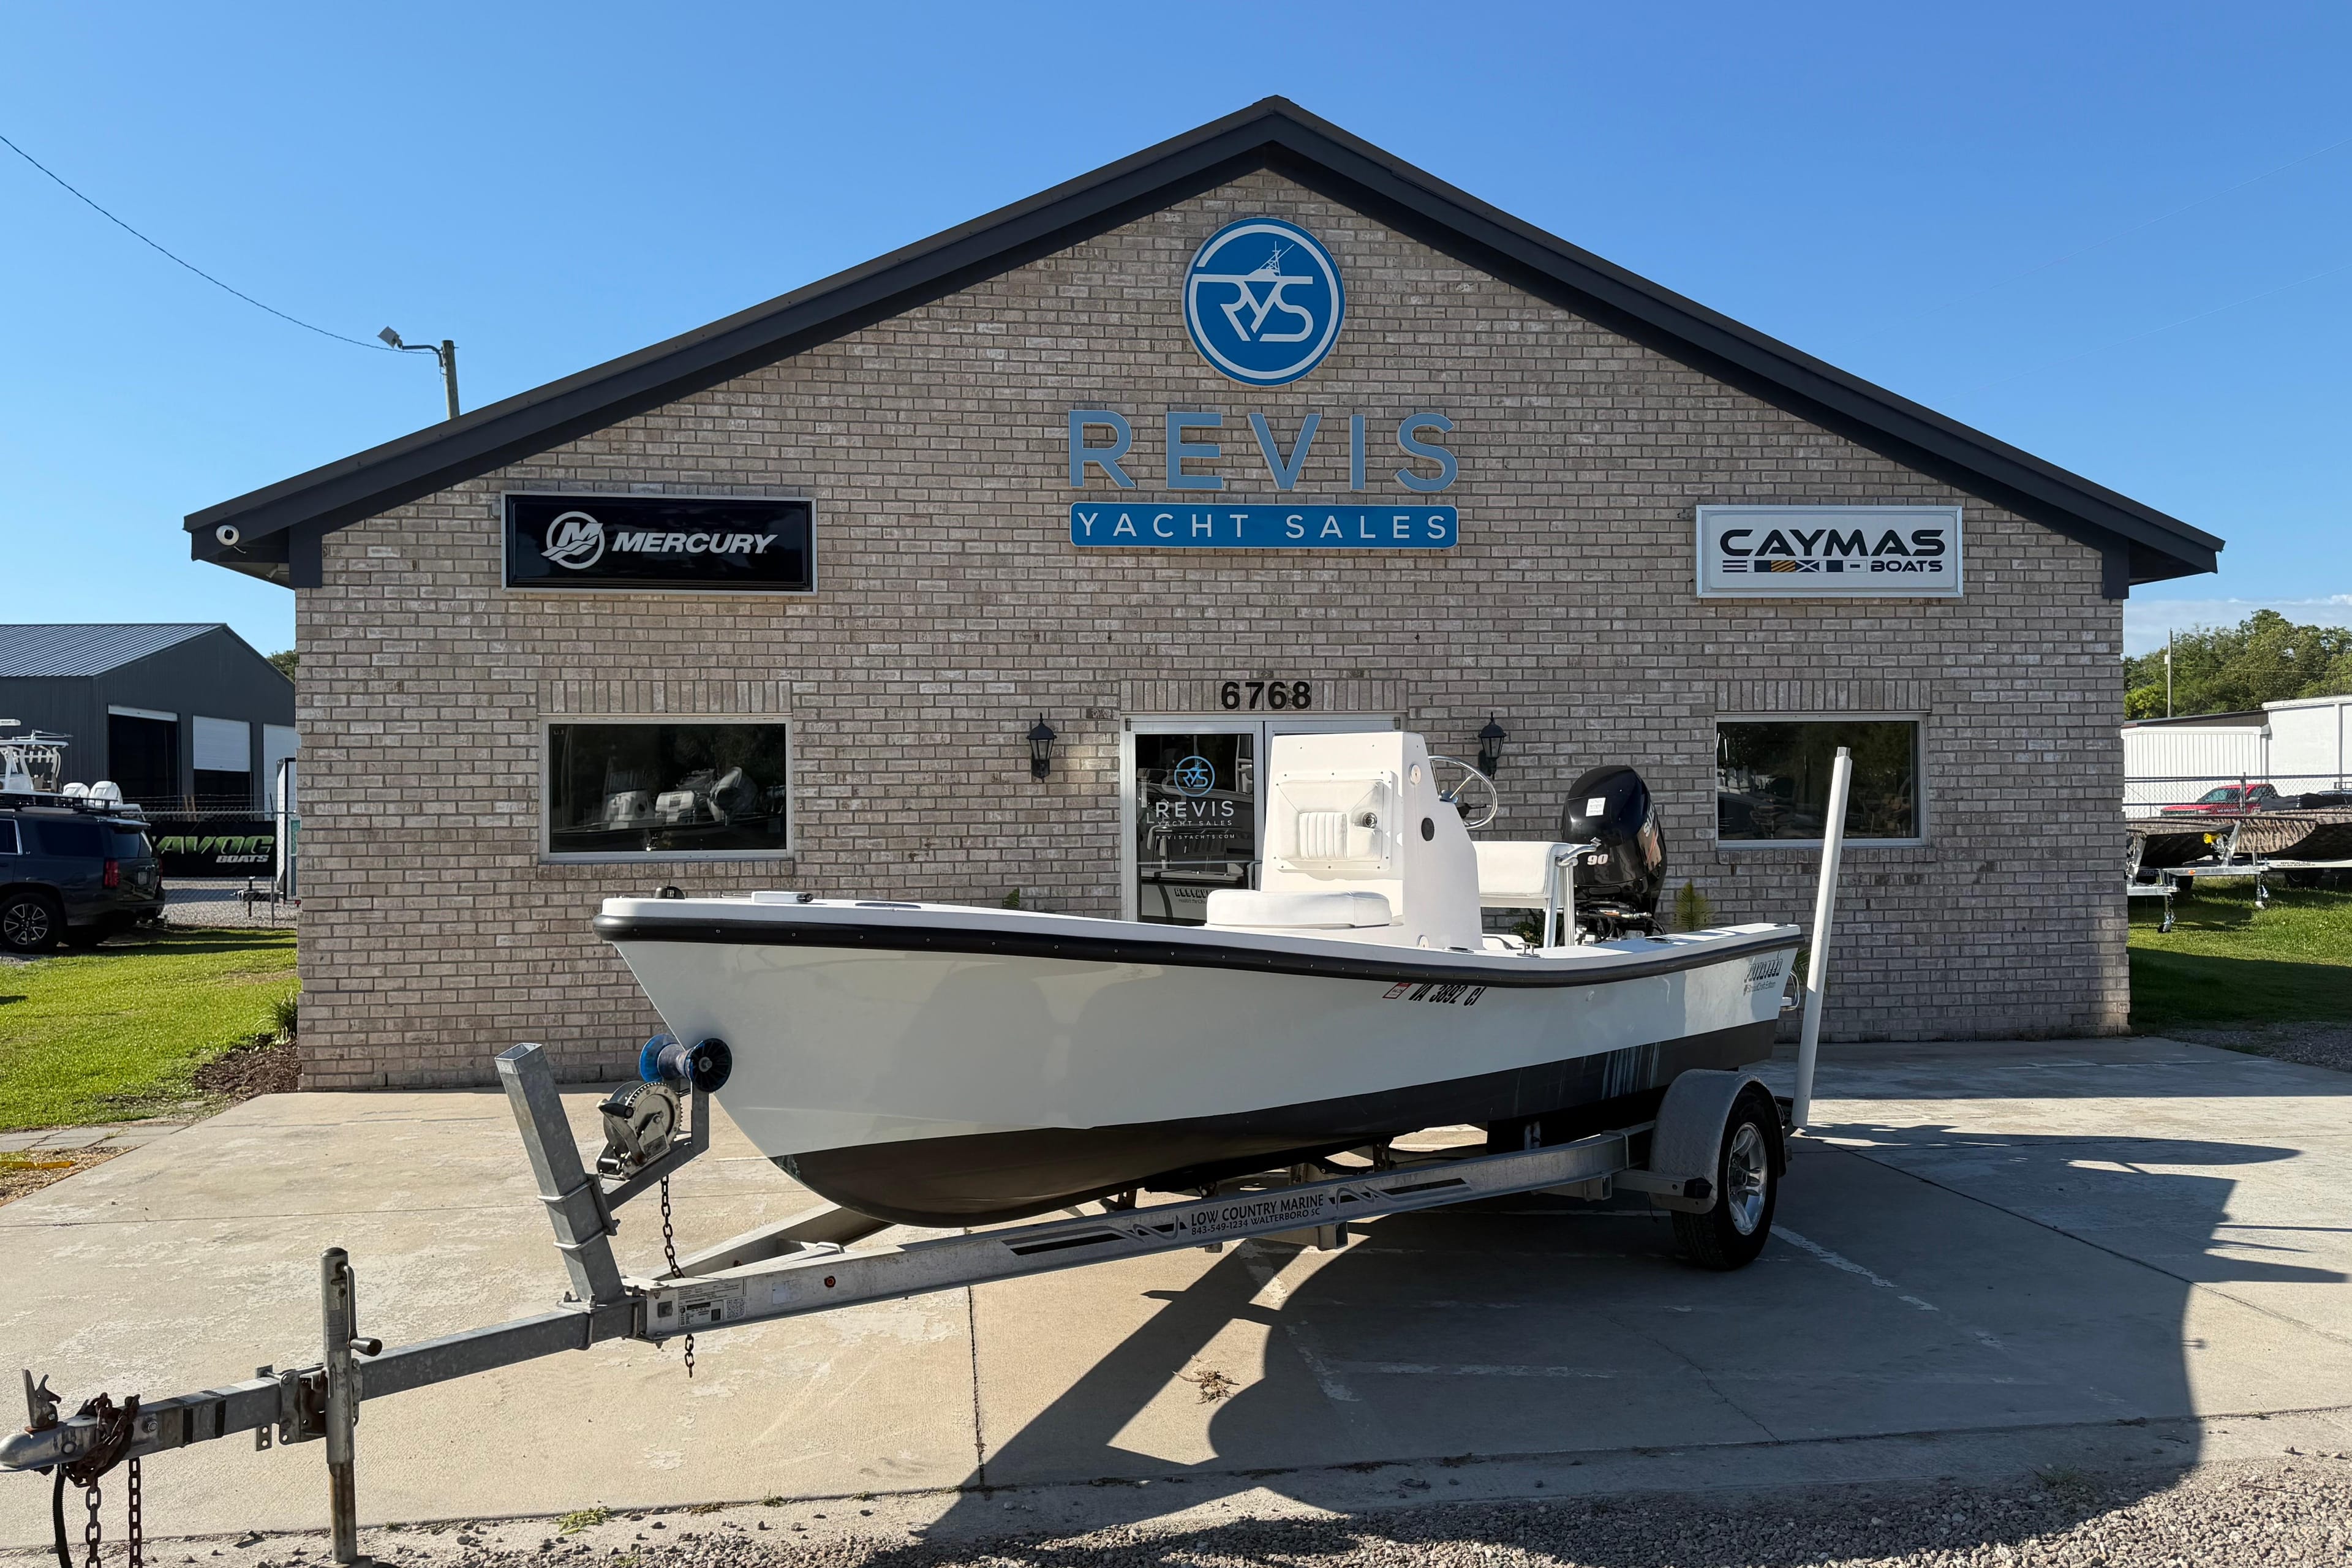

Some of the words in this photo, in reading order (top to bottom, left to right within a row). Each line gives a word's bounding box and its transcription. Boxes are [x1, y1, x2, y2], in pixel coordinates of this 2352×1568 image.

[1068, 409, 1458, 492] REVIS
[1077, 512, 1249, 538] YACHT
[1285, 514, 1446, 539] SALES
[611, 532, 778, 554] MERCURY
[1720, 529, 1946, 557] CAYMAS
[1870, 560, 1943, 573] BOATS
[1221, 681, 1311, 710] 6768
[1156, 800, 1234, 818] REVIS
[153, 835, 275, 855] AVOC
[216, 854, 270, 863] BOATS
[1587, 854, 1608, 865] 90
[1408, 984, 1434, 1001] VA
[1429, 985, 1468, 1004] 3892
[1191, 1210, 1219, 1226] LOW
[1222, 1200, 1278, 1221] COUNTRY
[1281, 1194, 1324, 1211] MARINE
[1191, 1219, 1248, 1235] 843-549-1234
[1251, 1209, 1309, 1225] WALTERBORO
[1311, 1207, 1321, 1216] SC
